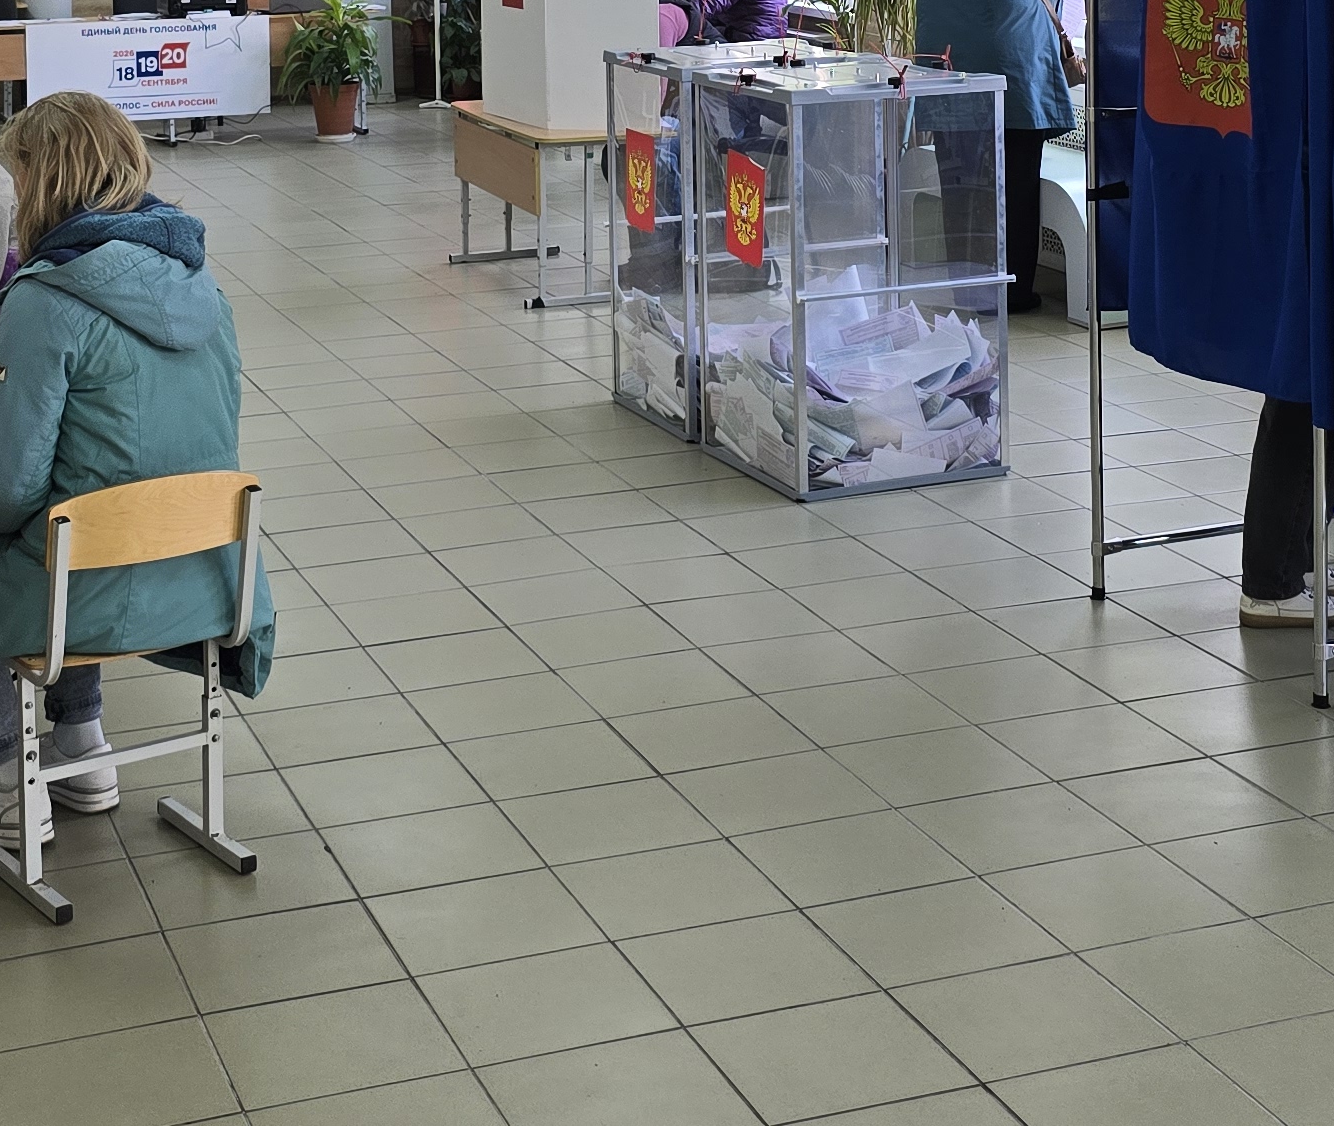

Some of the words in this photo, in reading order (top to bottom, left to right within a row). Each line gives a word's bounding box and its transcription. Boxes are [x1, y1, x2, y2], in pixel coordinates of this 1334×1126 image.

[81, 26, 120, 37] ЕДИНЫЙ
[123, 26, 147, 35] ДЕНЬ
[149, 24, 217, 34] ГОЛОСОВАНИЯ
[116, 67, 135, 81] 18
[138, 56, 158, 73] 19
[161, 48, 185, 64] 20
[141, 78, 188, 87] СЕНТЯБРЯ
[151, 100, 176, 108] СИЛА
[178, 98, 218, 107] РОССИИ!
